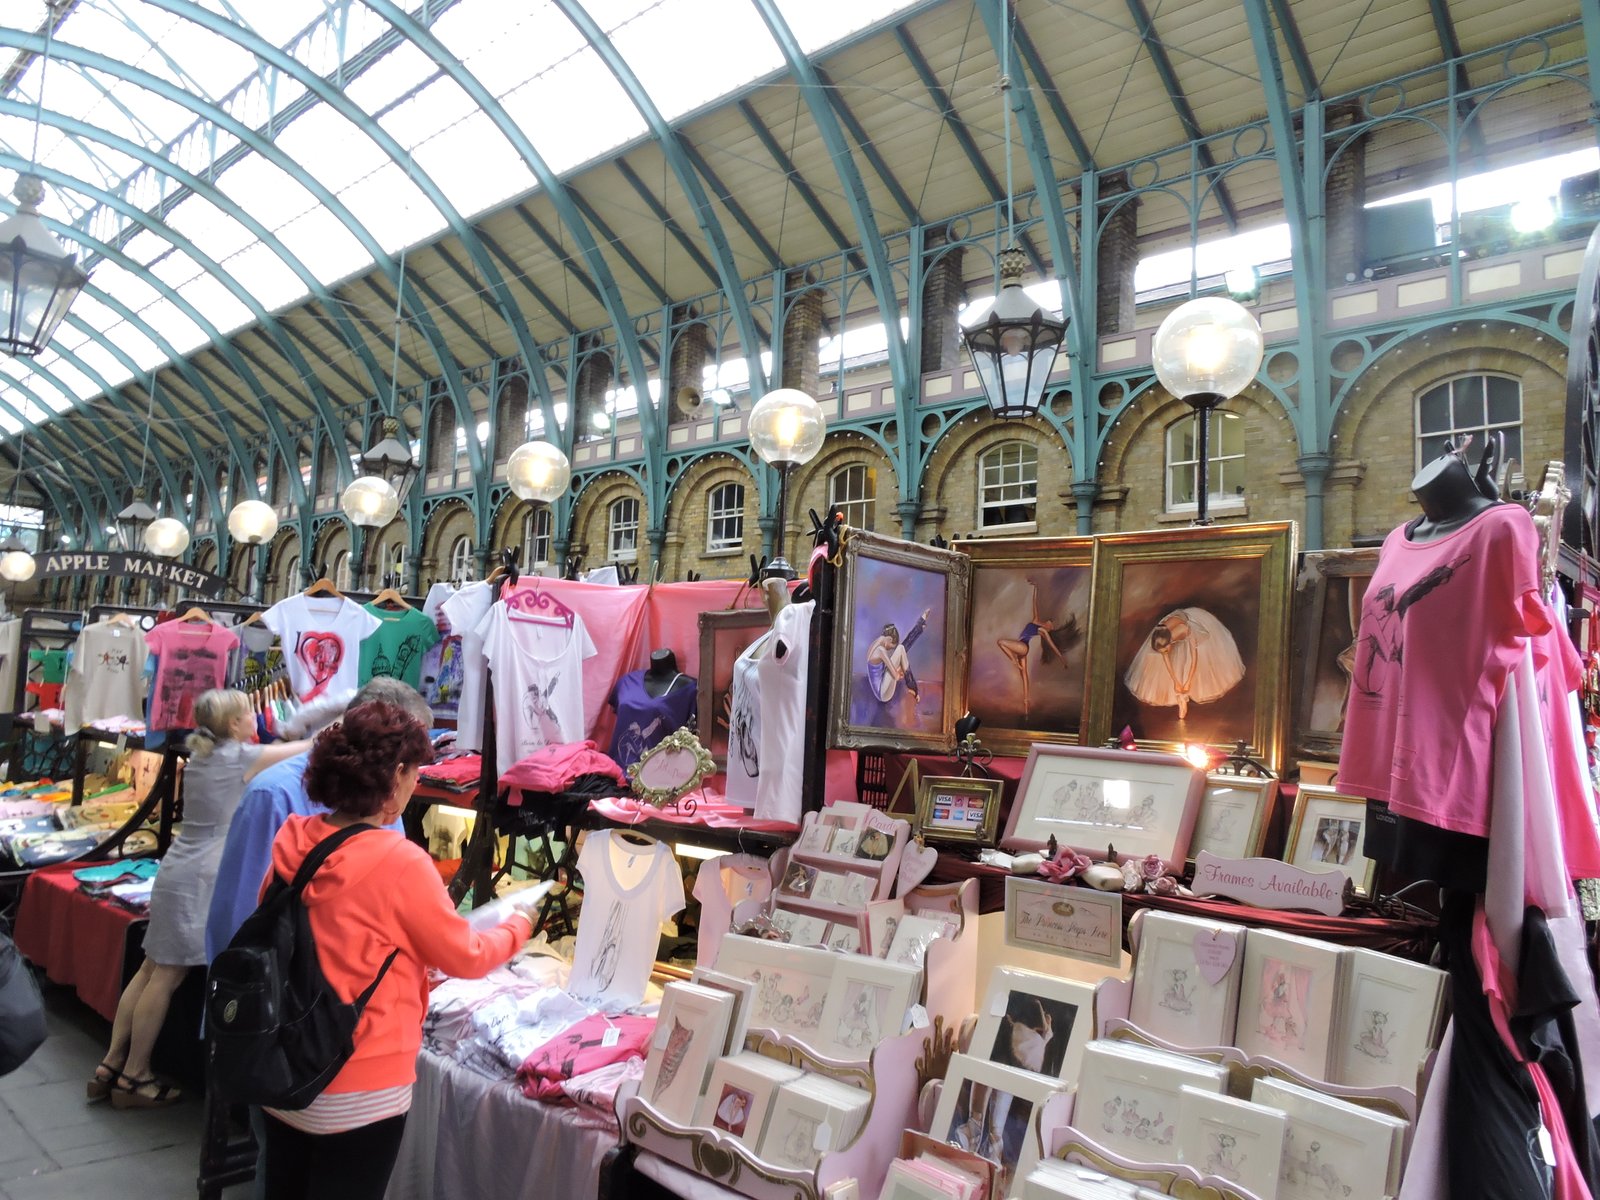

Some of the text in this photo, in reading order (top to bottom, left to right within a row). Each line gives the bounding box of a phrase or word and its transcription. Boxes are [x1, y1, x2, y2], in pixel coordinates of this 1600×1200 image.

[46, 555, 110, 572] APPLE
[1204, 864, 1334, 900] Frames Available
